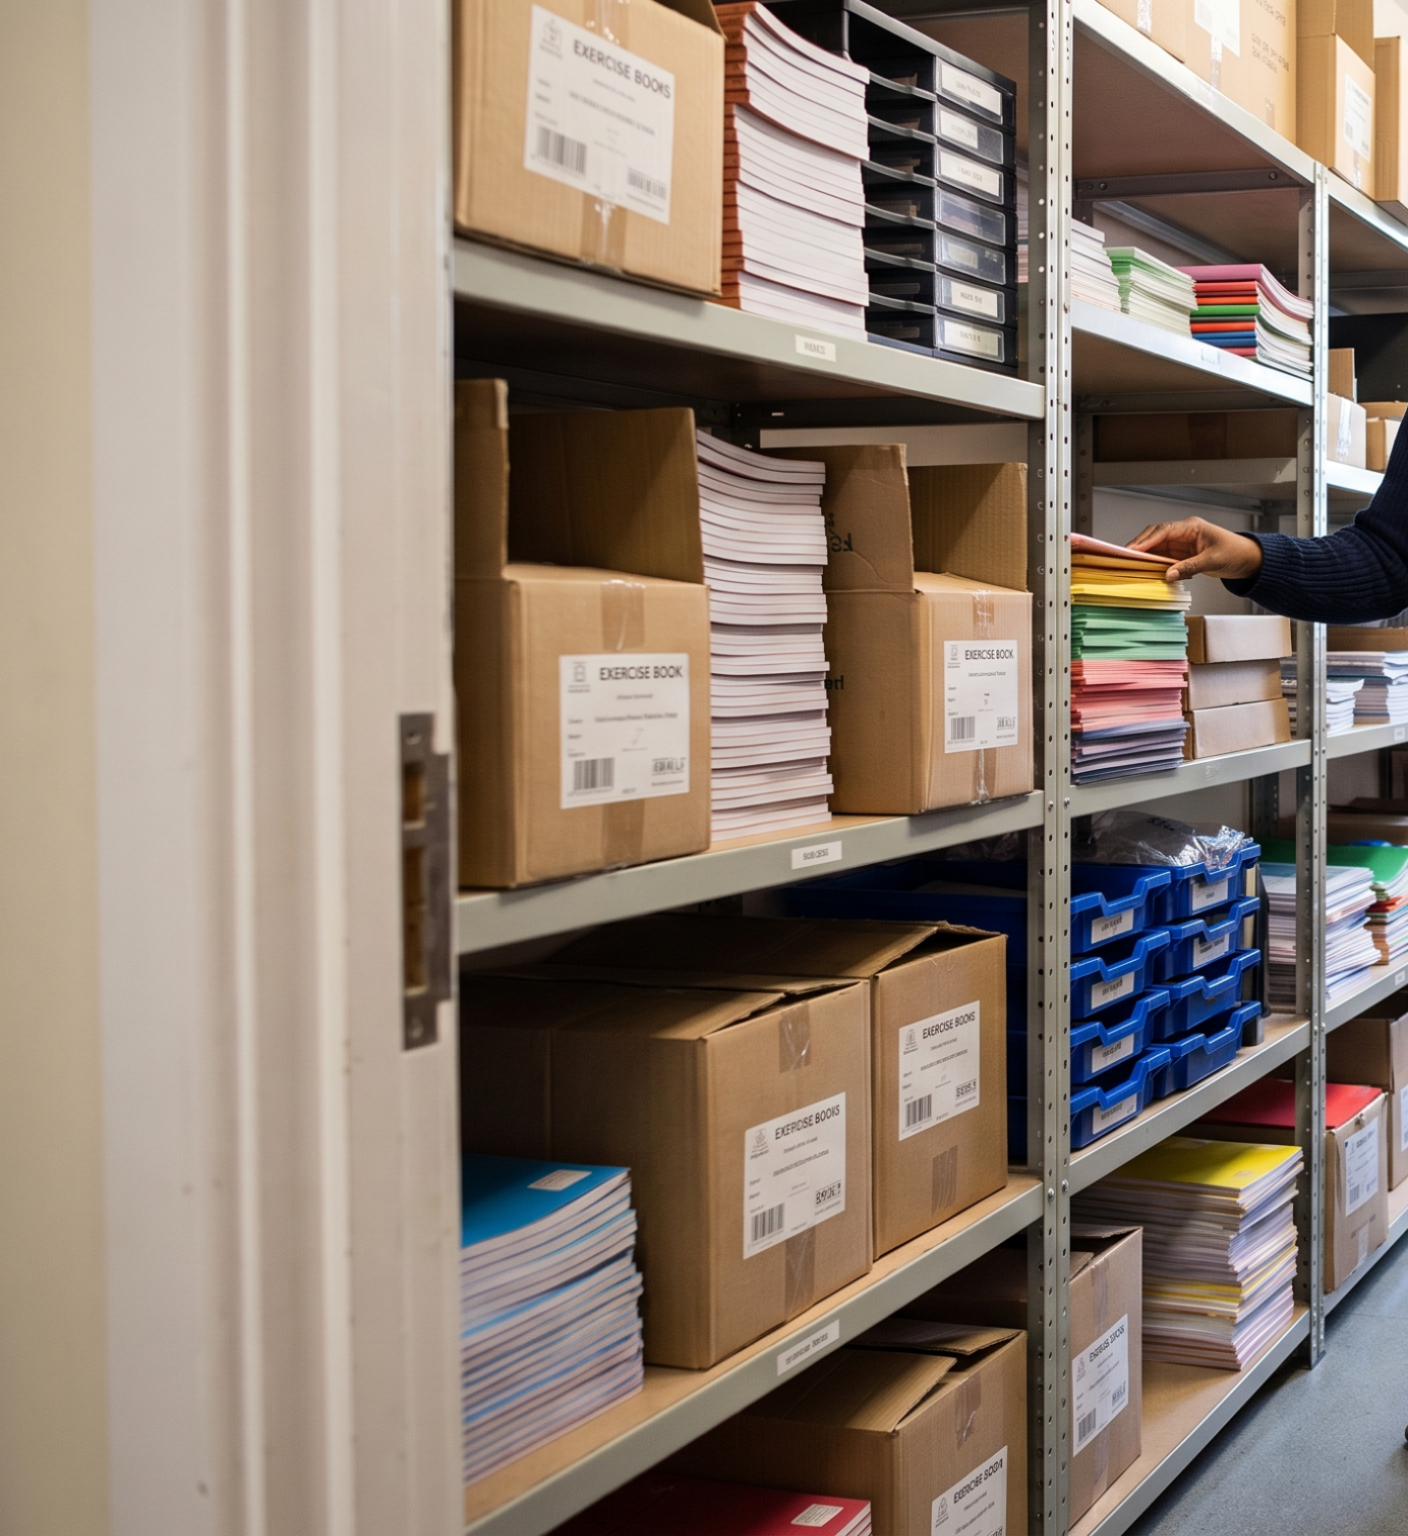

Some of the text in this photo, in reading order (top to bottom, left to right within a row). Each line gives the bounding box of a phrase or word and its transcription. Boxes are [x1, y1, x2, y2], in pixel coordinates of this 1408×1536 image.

[573, 39, 631, 81] EXERCISE
[634, 69, 672, 99] BOOKS
[965, 649, 1014, 660] EXERCISE BOOK
[599, 665, 683, 681] EXERCISE BOOK
[922, 1018, 954, 1040] EXERCISE
